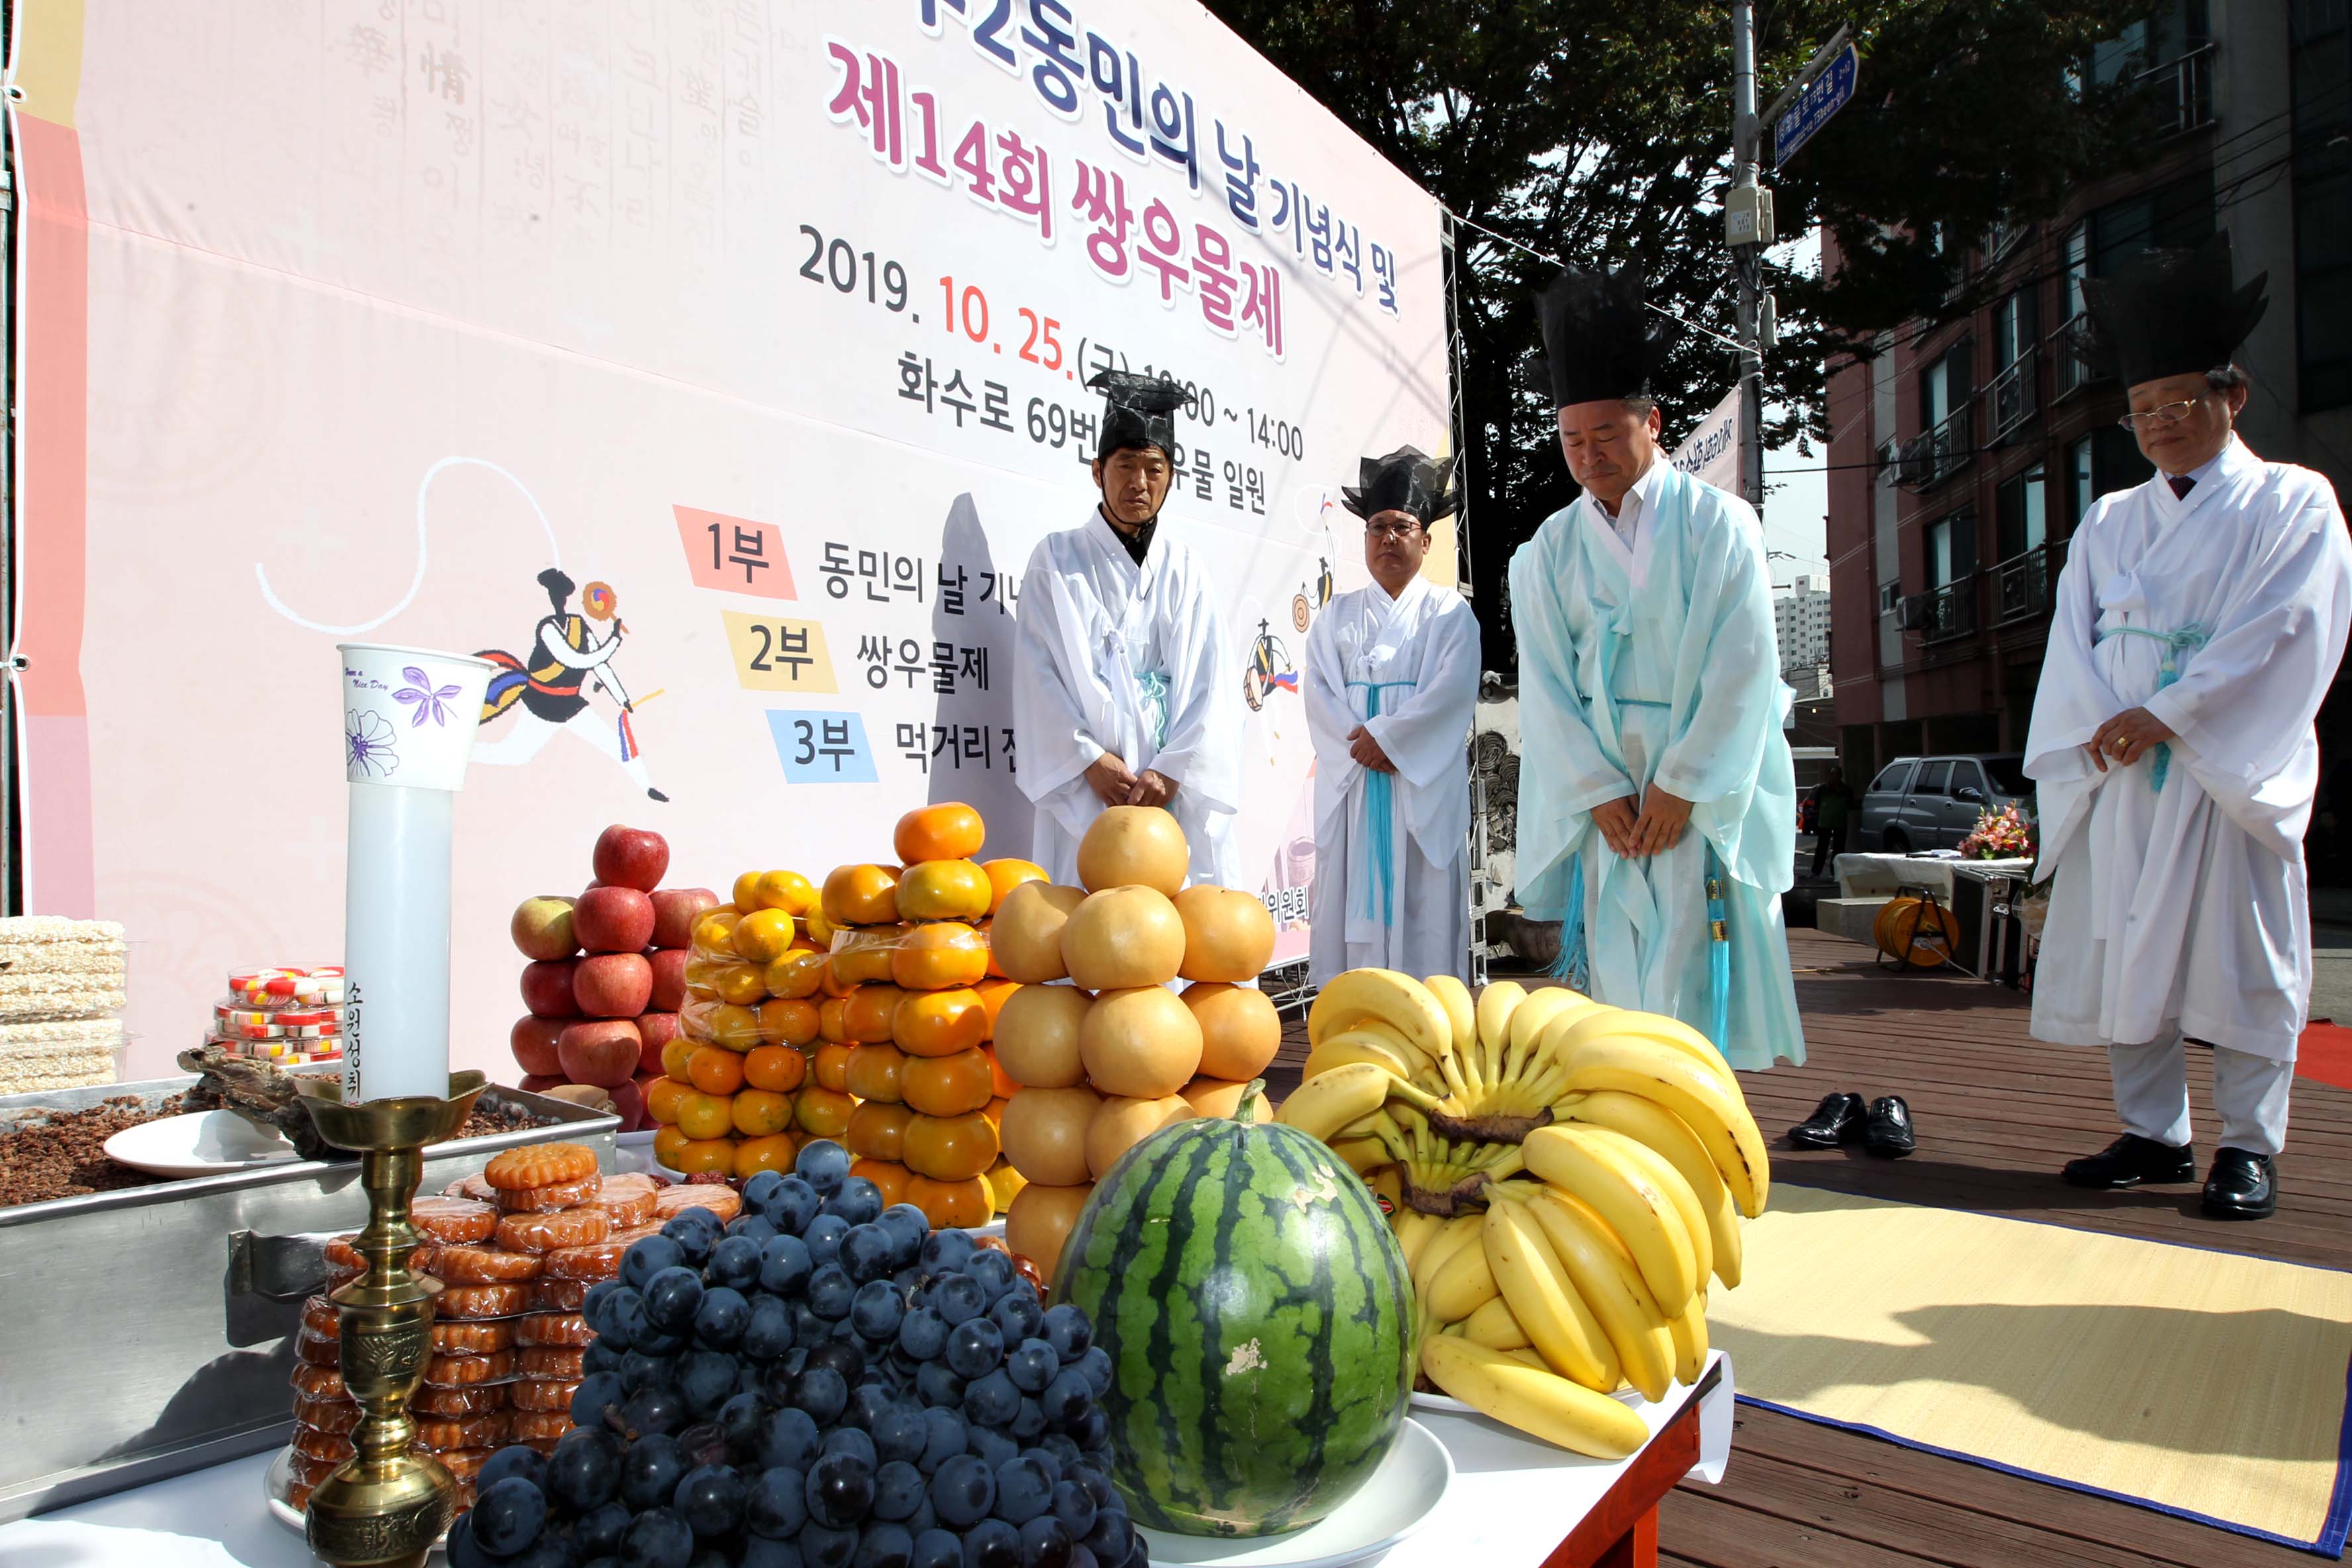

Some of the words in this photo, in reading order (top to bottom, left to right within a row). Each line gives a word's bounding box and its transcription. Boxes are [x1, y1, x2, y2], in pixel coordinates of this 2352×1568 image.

[828, 42, 1052, 240] 제14회
[1072, 160, 1283, 356] 쌍우물제
[921, 0, 1199, 191] 2동민의
[1214, 119, 1261, 228] 날
[1270, 178, 1362, 291] 기념식
[1370, 236, 1398, 315] 및
[799, 224, 920, 324] 2019.
[939, 275, 1001, 354] 10.
[1247, 407, 1304, 462] 14:00
[897, 350, 1014, 434] 화수로
[1223, 460, 1265, 516] 일원
[707, 522, 770, 585] 1부
[818, 541, 924, 603] 동민의
[937, 563, 969, 616] 날
[353, 679, 368, 688] Nice
[370, 679, 389, 691] Day
[750, 624, 814, 681] 2부
[857, 635, 989, 695] 쌍우물제
[793, 718, 856, 773] 3부
[896, 722, 991, 775] 먹거리
[346, 981, 364, 1099] 소원성취
